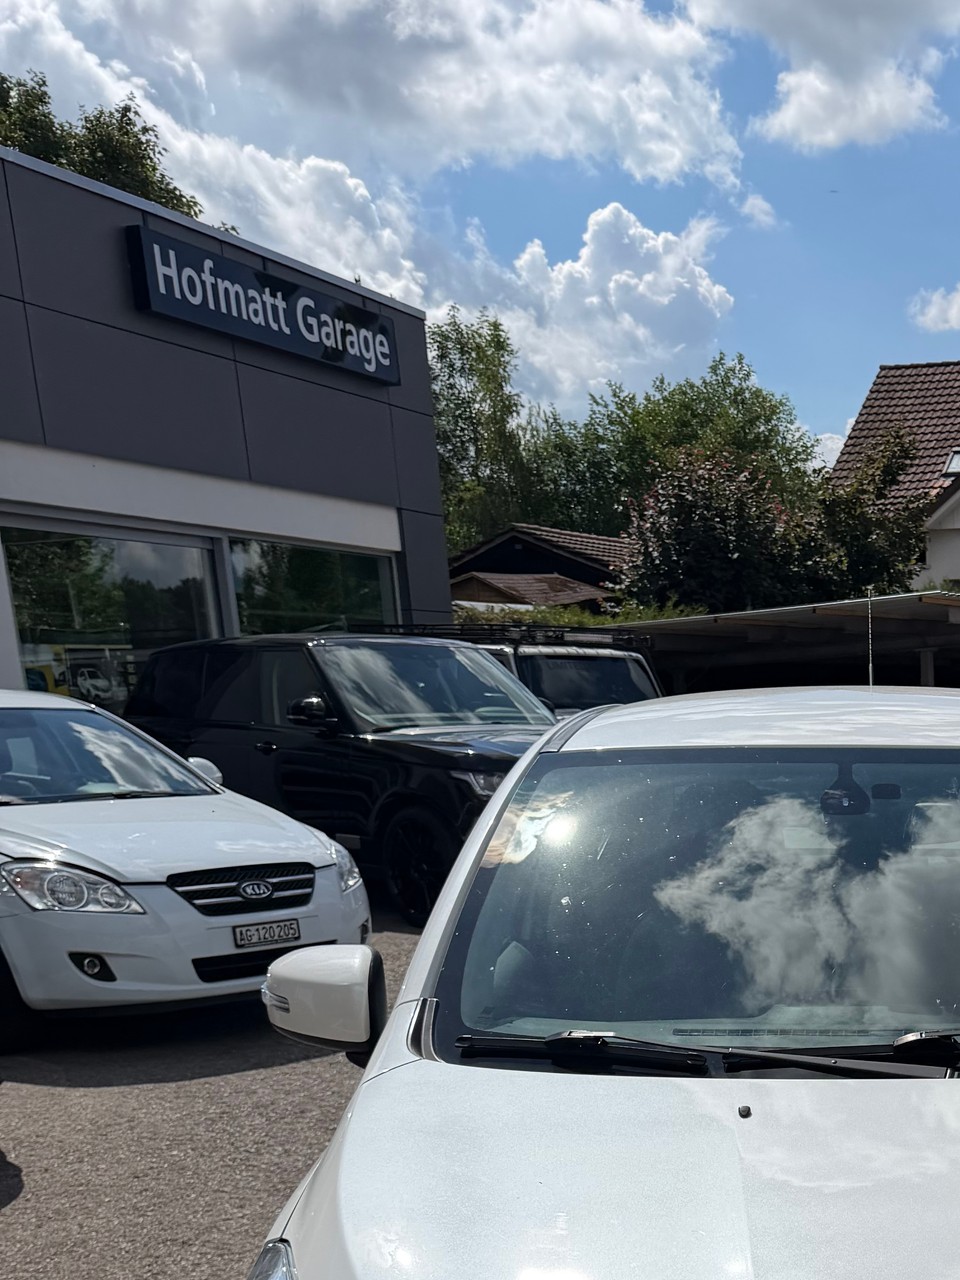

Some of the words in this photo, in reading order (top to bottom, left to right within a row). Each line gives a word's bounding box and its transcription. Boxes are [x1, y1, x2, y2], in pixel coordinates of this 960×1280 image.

[152, 243, 291, 334] Hofmatt
[296, 296, 390, 372] Garage
[246, 884, 269, 895] KIA
